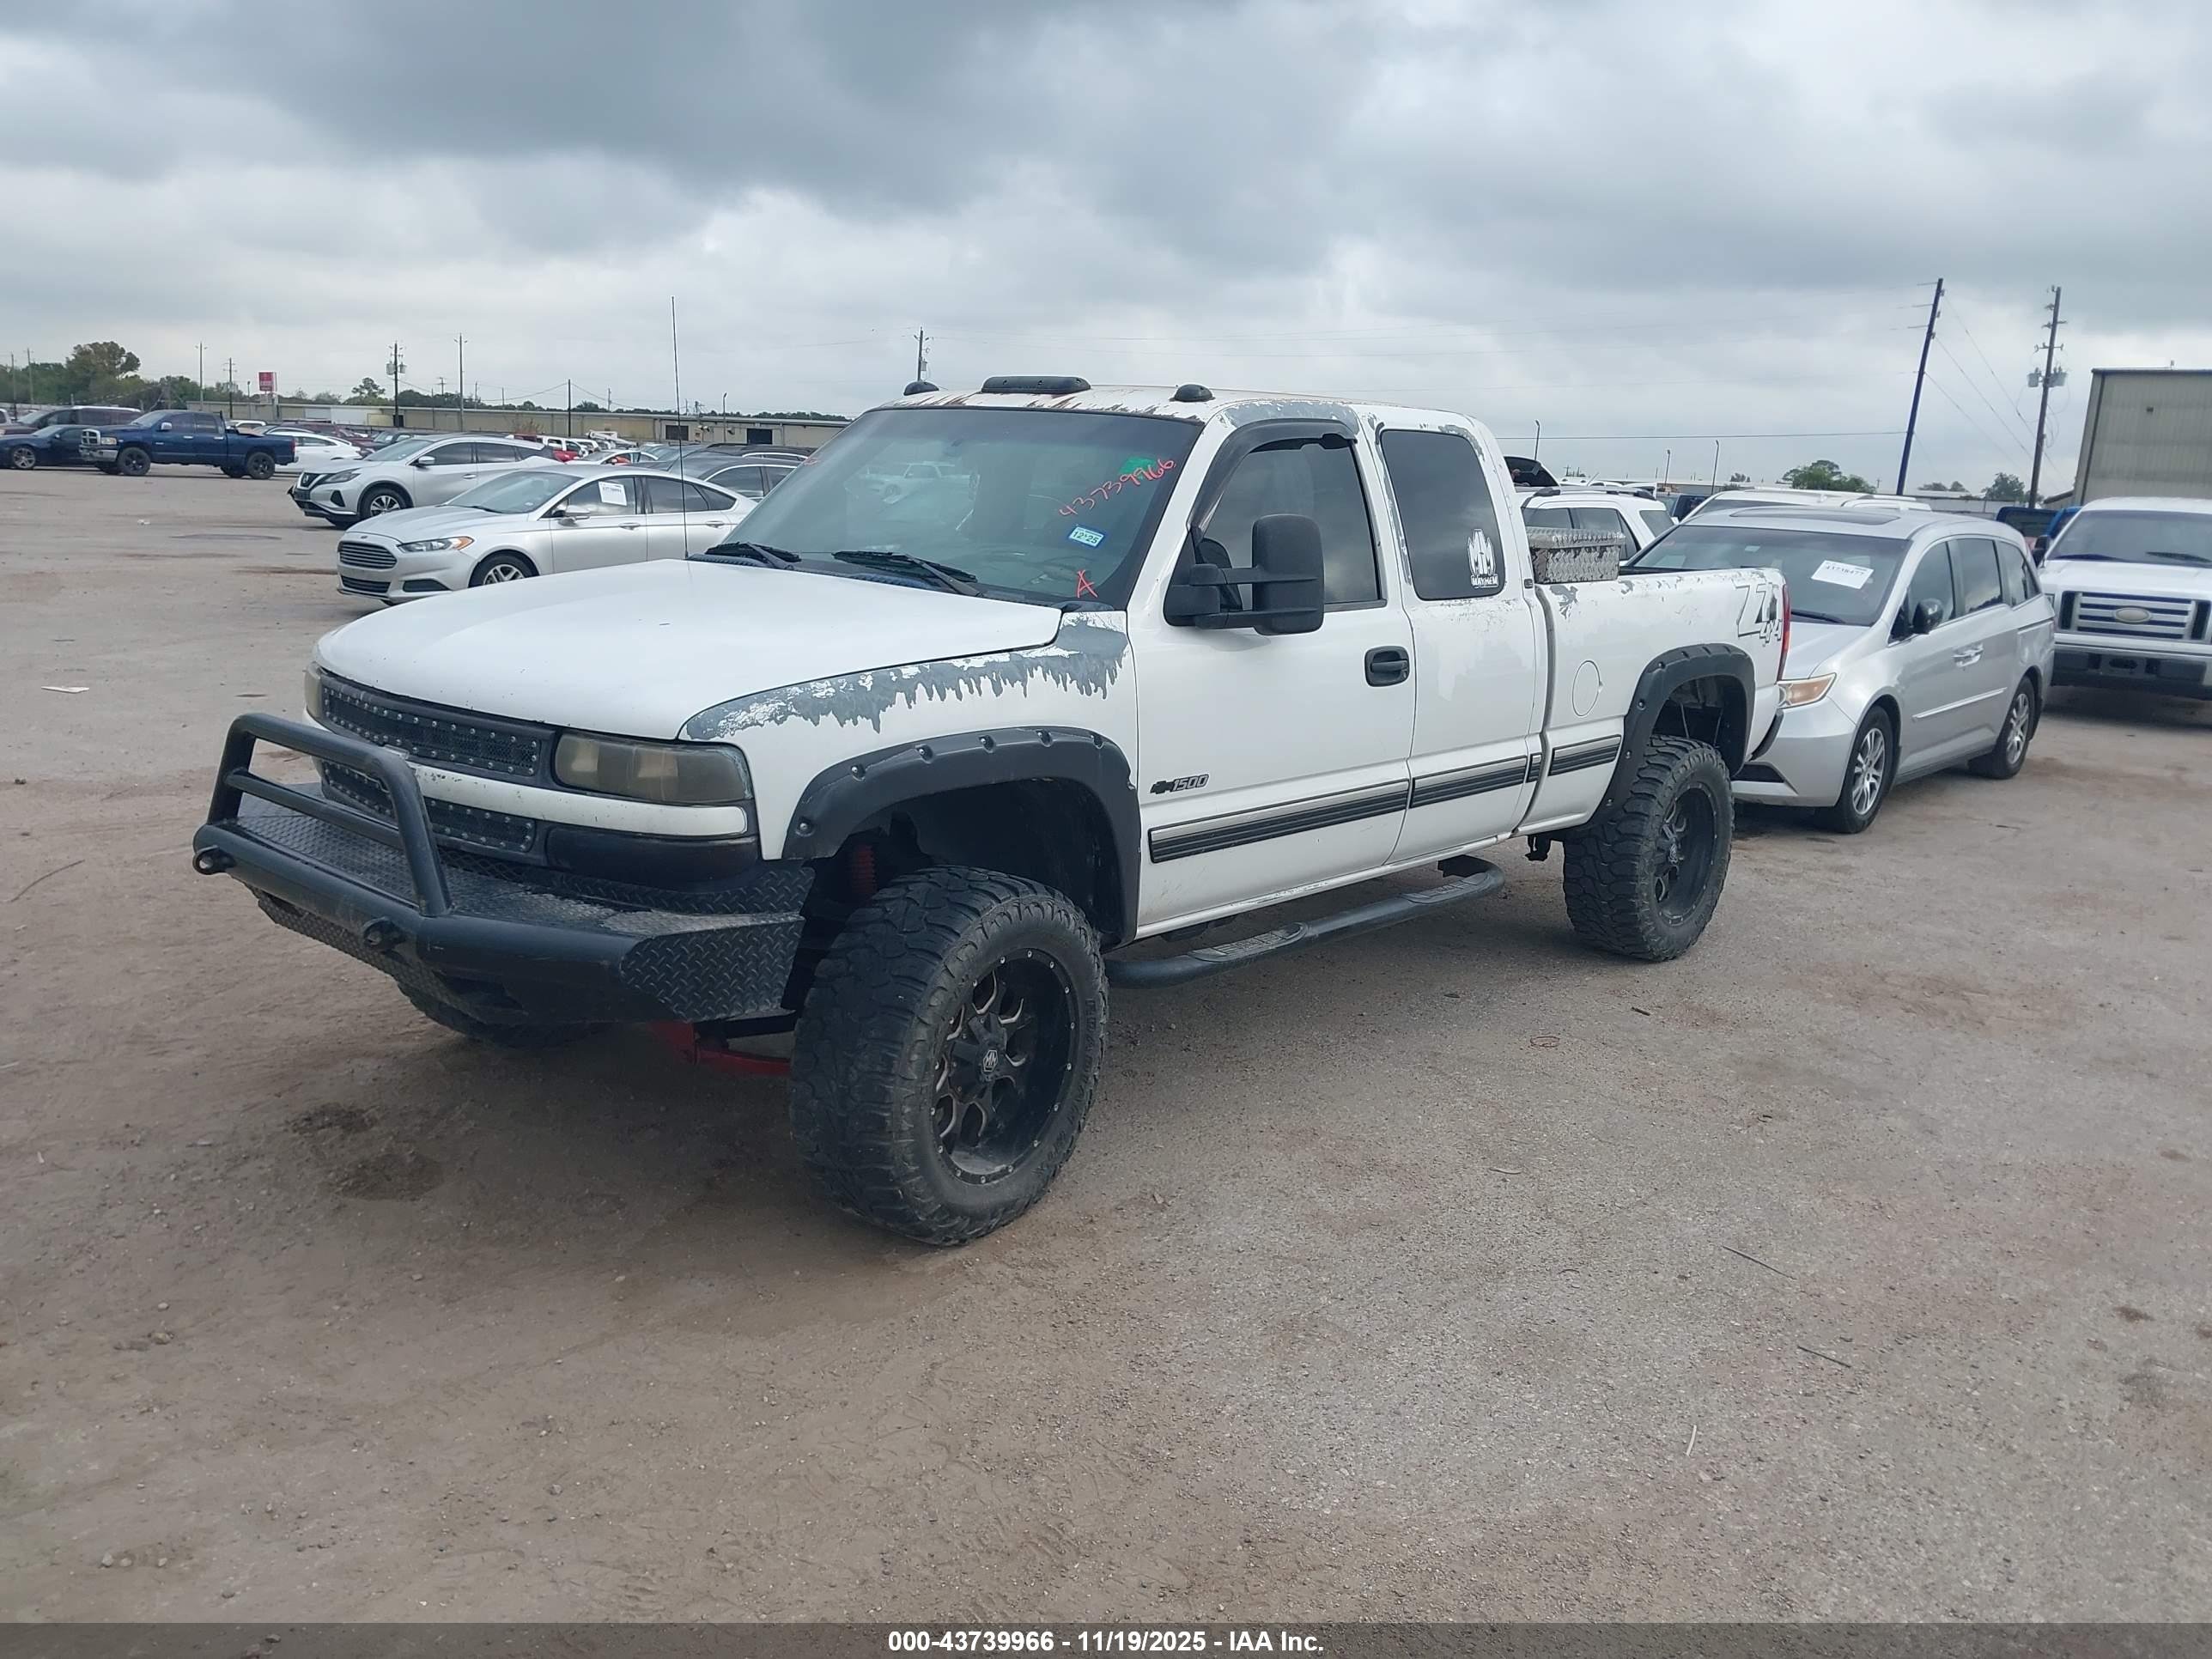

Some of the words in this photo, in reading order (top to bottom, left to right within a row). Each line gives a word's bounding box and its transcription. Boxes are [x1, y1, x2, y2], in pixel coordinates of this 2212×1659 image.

[1059, 459, 1176, 516] 43739966
[1073, 531, 1085, 539] 12
[1085, 535, 1099, 544] 25
[1077, 569, 1098, 598] A
[1471, 574, 1498, 586] MAYHEM
[1172, 775, 1209, 792] 1500
